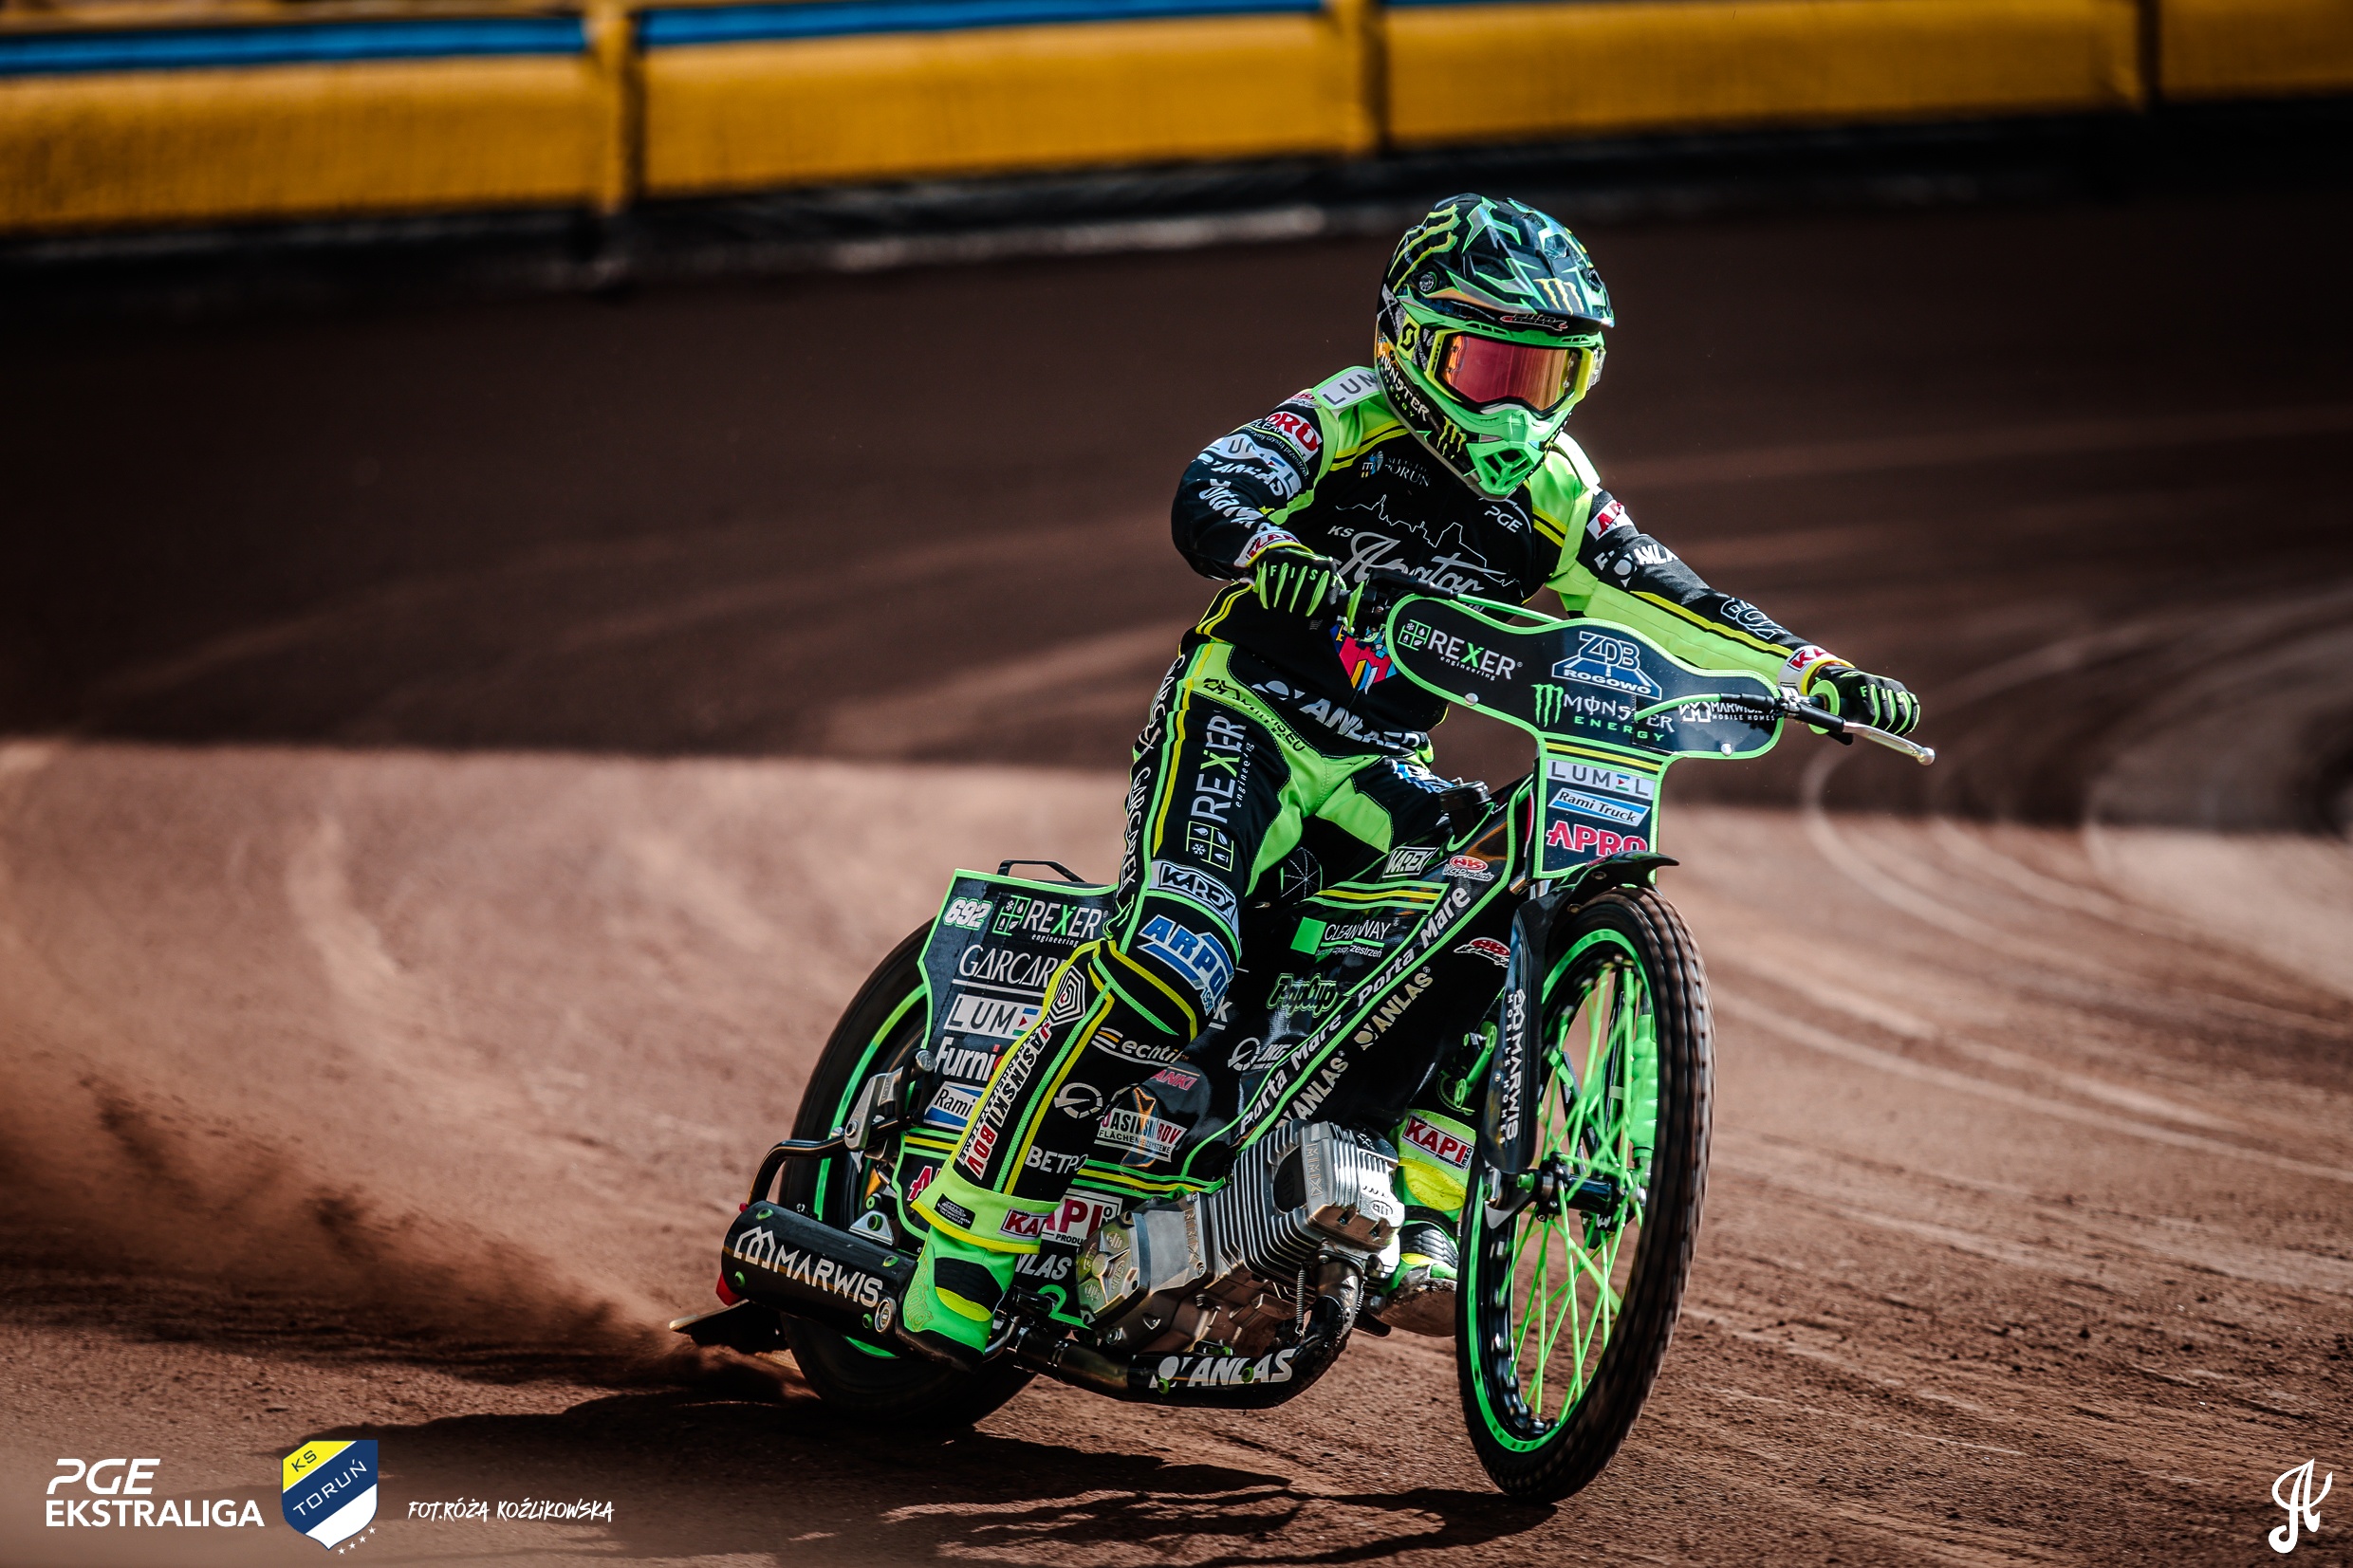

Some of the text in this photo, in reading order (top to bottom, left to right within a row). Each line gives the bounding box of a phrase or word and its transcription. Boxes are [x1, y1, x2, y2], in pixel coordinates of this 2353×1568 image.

[1324, 374, 1378, 406] LUM
[1327, 526, 1354, 537] KS
[1484, 506, 1523, 532] PGE
[1428, 629, 1515, 680] REXER
[1439, 655, 1496, 681] engineering
[1579, 630, 1640, 672] ZDB
[1563, 668, 1652, 695] ROGOWO
[1574, 715, 1664, 743] ENERGY
[1558, 790, 1638, 823] Rami Truck
[944, 898, 992, 930] 692
[1022, 900, 1102, 940] REXER
[1031, 933, 1080, 949] engineering
[1357, 947, 1416, 1007] Porta
[1419, 887, 1471, 950] Mare
[959, 944, 1067, 988] GARCAR
[1372, 971, 1435, 1034] ANLAS
[1239, 1068, 1288, 1135] Porta
[1289, 1014, 1342, 1071] Mare
[1291, 1057, 1349, 1120] ANLAS
[1506, 1031, 1524, 1140] MARWIS
[935, 1088, 977, 1117] Rami
[1404, 1118, 1468, 1164] KAPI
[773, 1244, 883, 1308] MARWIS
